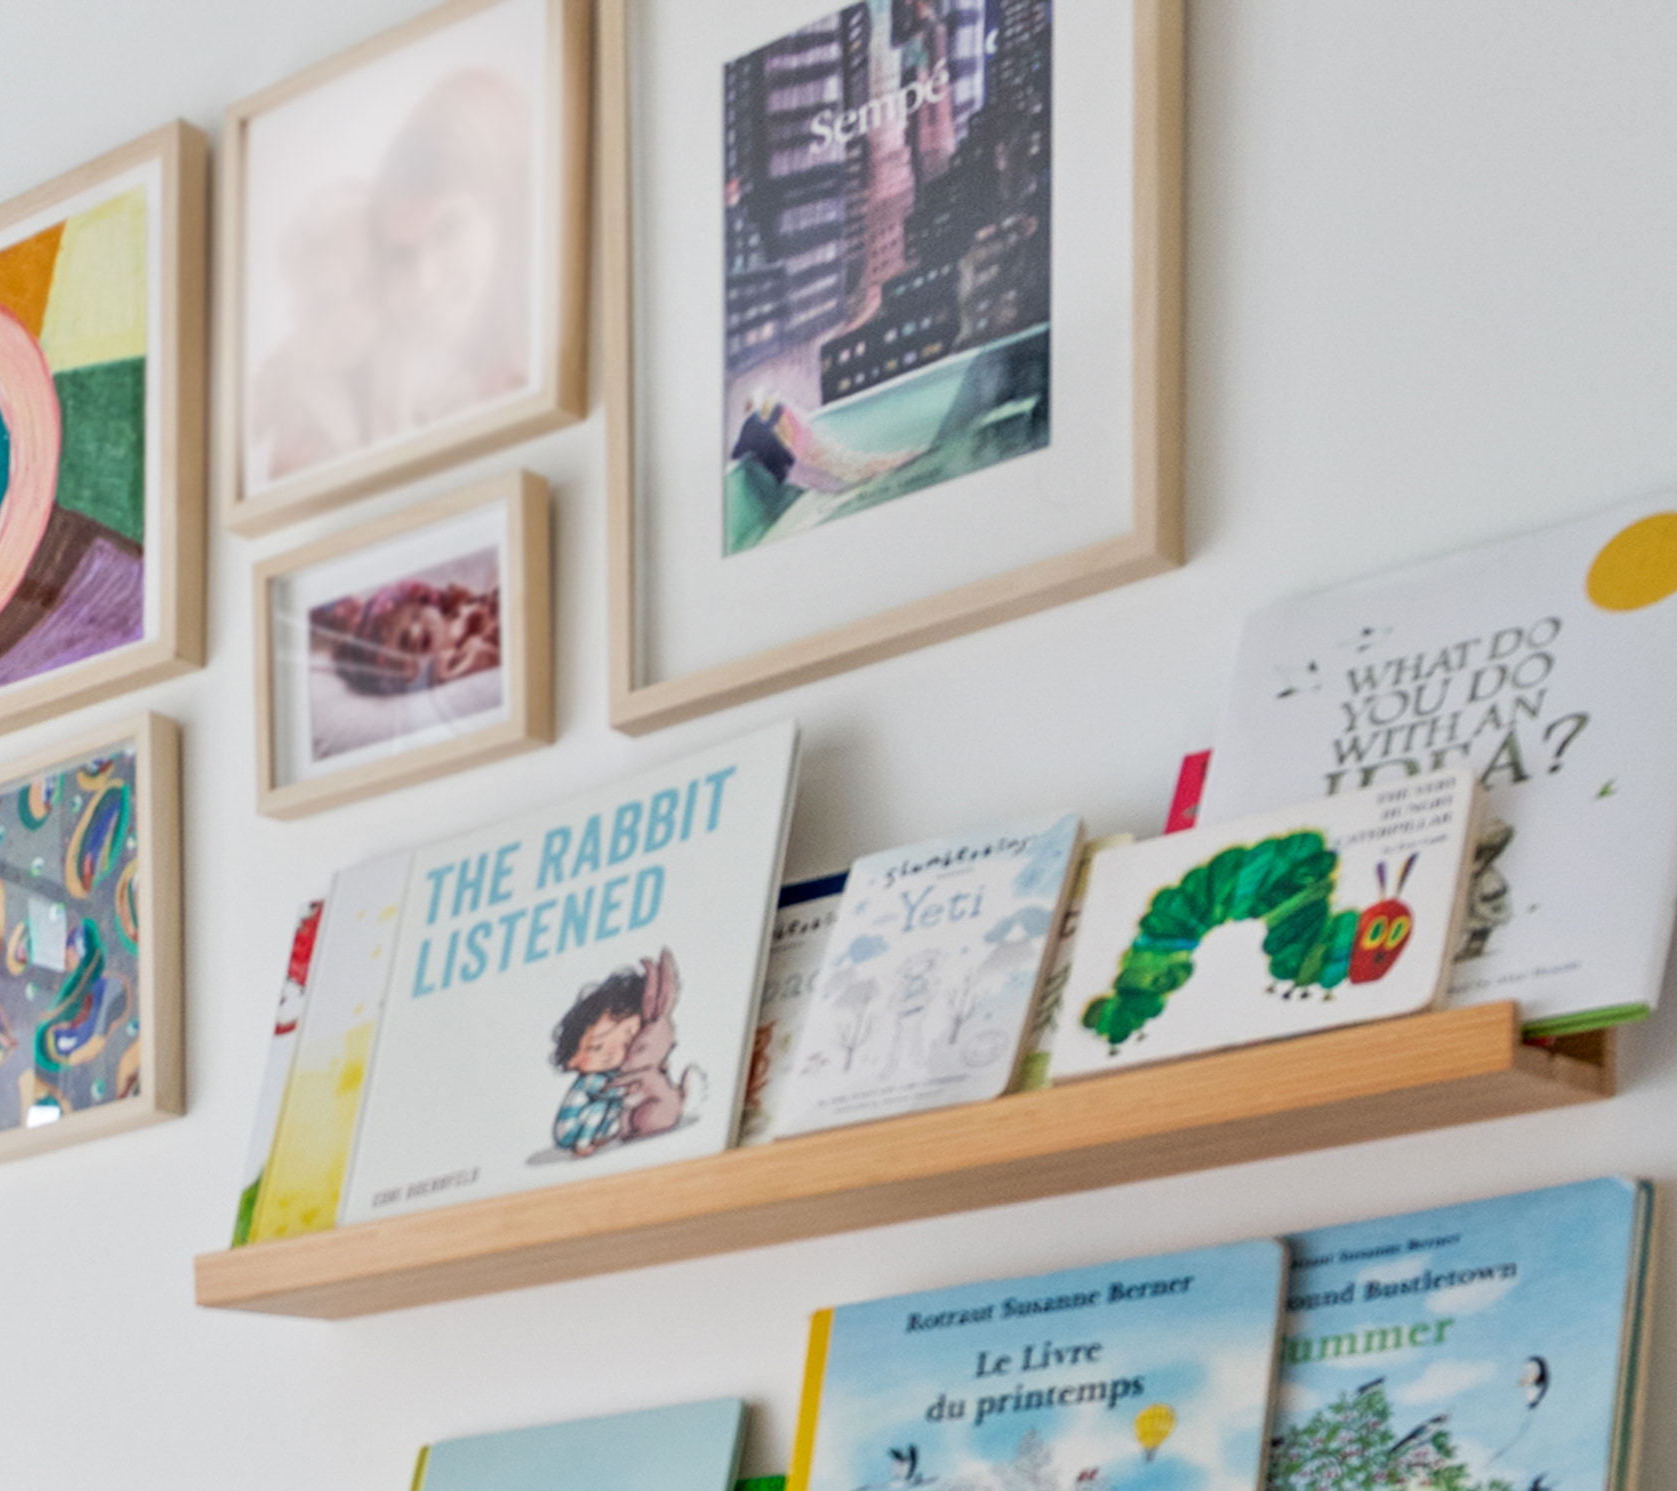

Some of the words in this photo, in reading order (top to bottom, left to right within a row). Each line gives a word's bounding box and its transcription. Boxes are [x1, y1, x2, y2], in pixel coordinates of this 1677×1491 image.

[808, 57, 950, 155] Sempé
[1347, 638, 1482, 694] WHAT
[1488, 616, 1563, 660] DO
[1341, 677, 1451, 733] YOU
[1467, 652, 1554, 703] DO
[1334, 711, 1462, 765] WITH
[1474, 689, 1547, 737] AN
[425, 841, 522, 926] THE
[535, 766, 736, 891] RABBIT
[411, 864, 667, 998] LISTENED
[901, 885, 985, 933] Yeti
[906, 1303, 994, 1334] Rotraut
[1001, 1288, 1100, 1319] Susanne
[1108, 1275, 1195, 1303] Berner
[1363, 1263, 1518, 1300] Bustletown
[974, 1350, 1012, 1379] Le
[1021, 1339, 1102, 1372] Livre
[1286, 1317, 1455, 1364] ummer
[925, 1394, 965, 1423] du
[974, 1373, 1144, 1426] printemps
